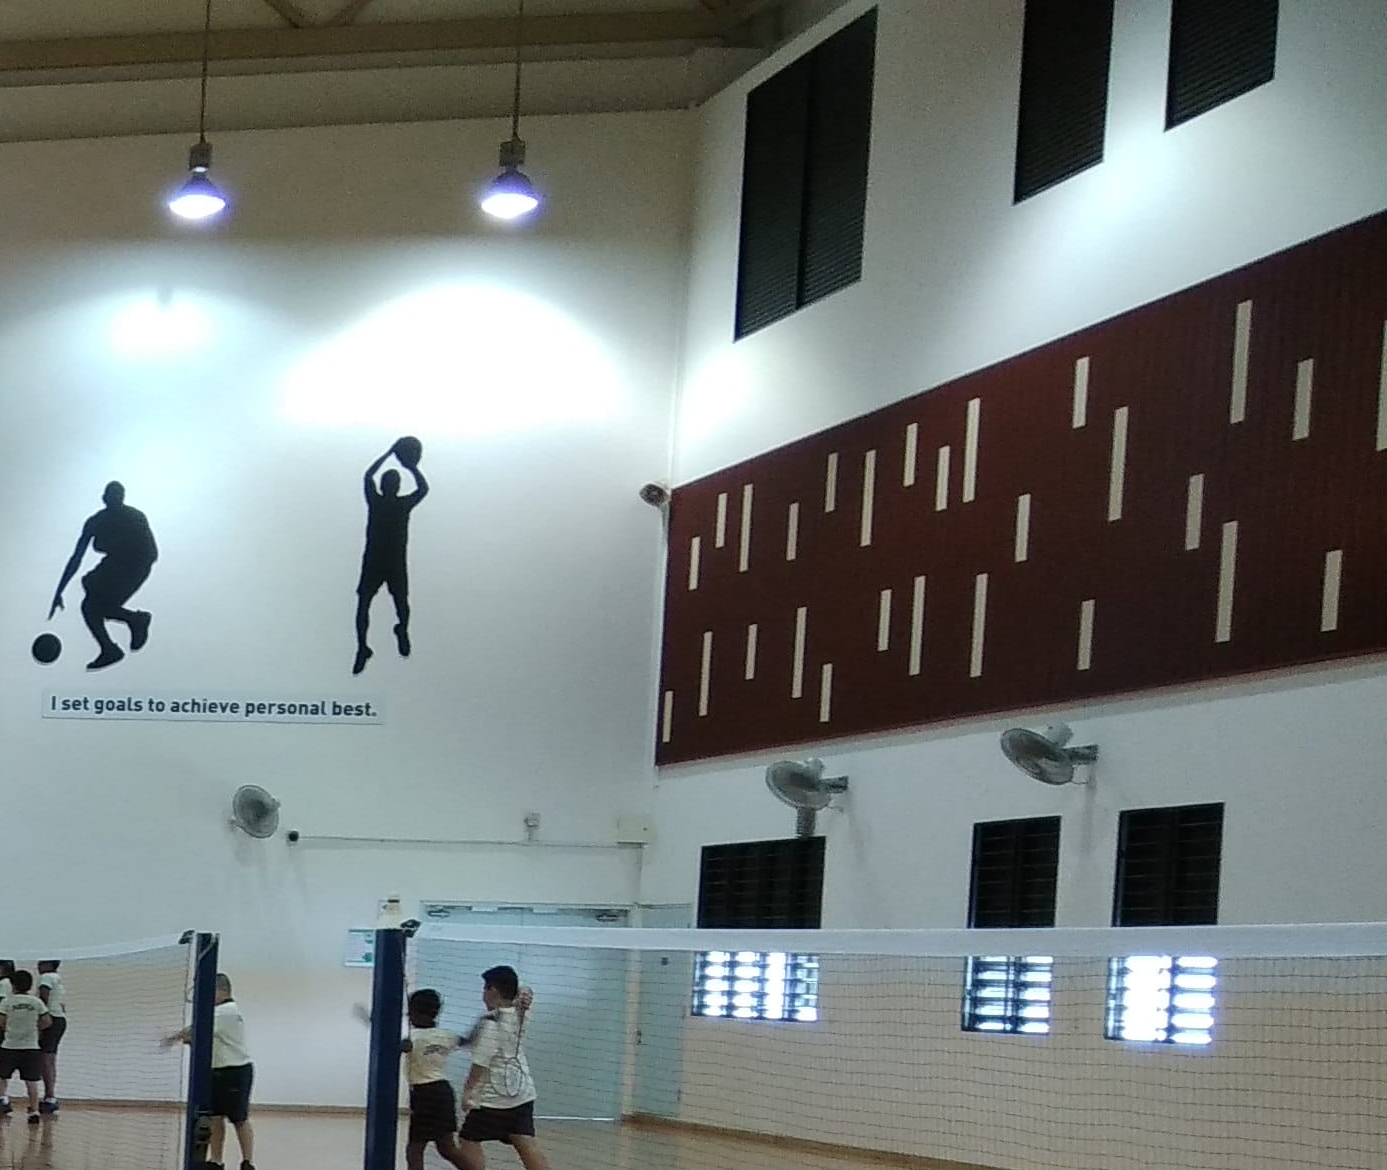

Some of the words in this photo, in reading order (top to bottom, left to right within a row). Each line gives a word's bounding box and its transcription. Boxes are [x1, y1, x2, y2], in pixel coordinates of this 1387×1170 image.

[51, 696, 57, 711] I
[61, 697, 90, 711] set
[94, 698, 144, 715] goals
[147, 698, 166, 713] to
[170, 698, 241, 715] achieve
[244, 701, 327, 718] personal
[332, 701, 378, 717] best.
